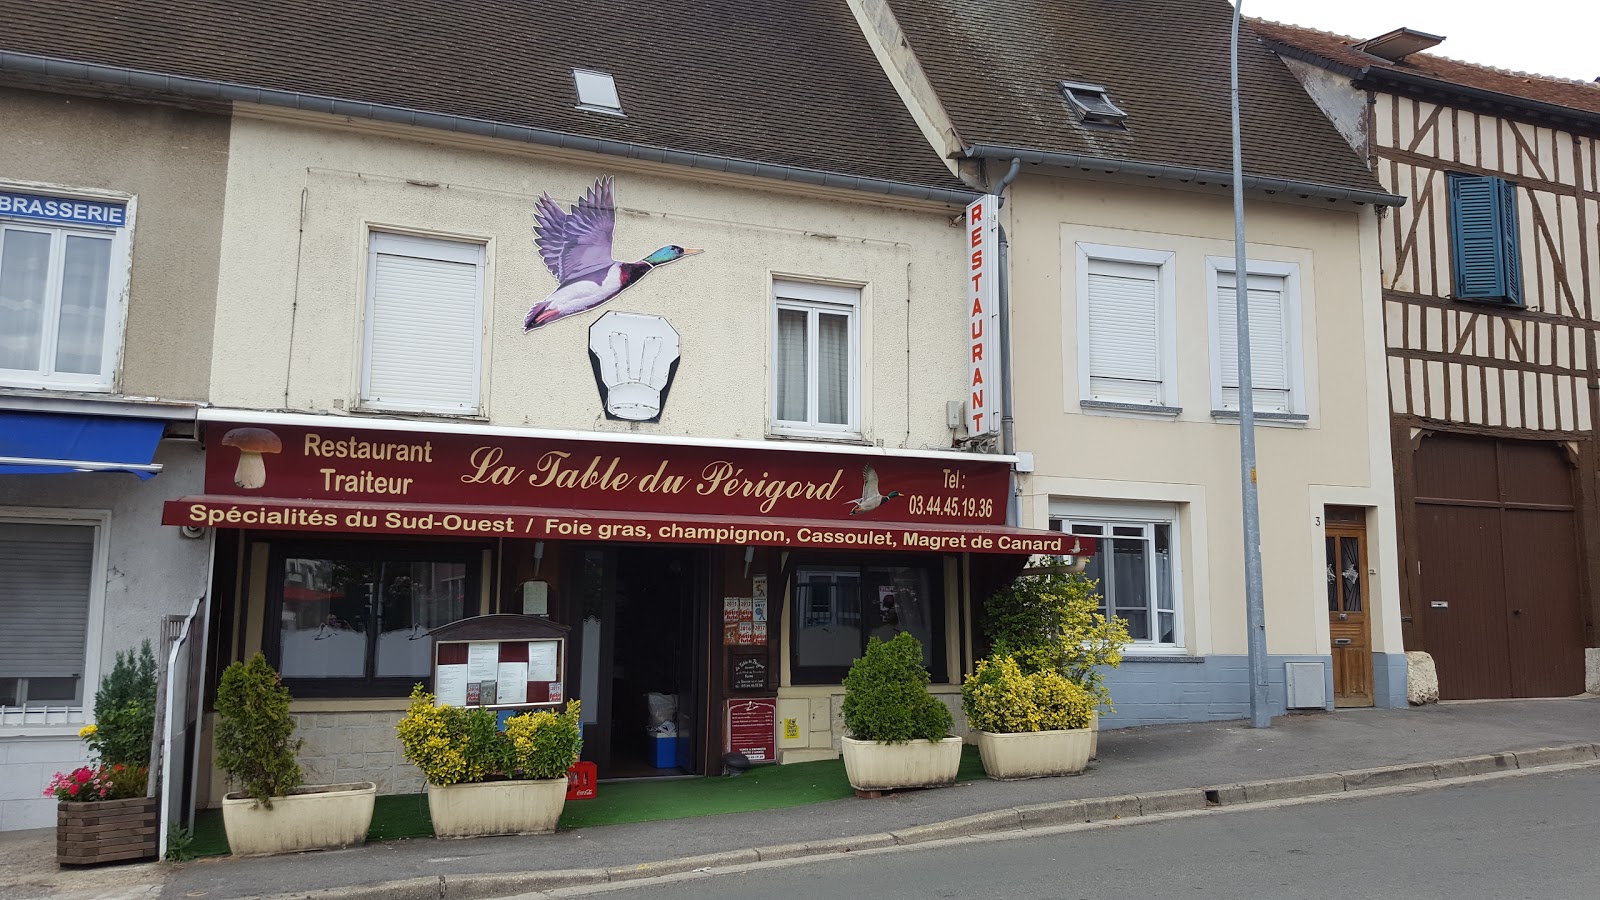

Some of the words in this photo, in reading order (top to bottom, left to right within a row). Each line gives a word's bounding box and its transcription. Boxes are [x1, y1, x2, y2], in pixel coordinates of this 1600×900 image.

[0, 196, 122, 222] BRASSERIE
[971, 203, 983, 433] RESTAURANT
[304, 433, 433, 463] Restaurant
[319, 468, 414, 495] Traiteur
[460, 445, 525, 486] La
[528, 450, 635, 492] Table
[636, 460, 692, 495] du
[695, 460, 845, 514] Périgord
[943, 468, 960, 489] Tel
[909, 494, 993, 518] 03.44.45.19.36
[189, 503, 338, 527] Spécialités
[345, 511, 377, 528] du
[385, 512, 515, 533] Sud-Ouest
[545, 518, 592, 536] Foie
[598, 524, 652, 541] gras,
[658, 523, 791, 546] champignon,
[796, 527, 897, 548] Cassoulet,
[903, 531, 967, 551] Magret
[970, 534, 993, 549] de
[997, 535, 1062, 552] Canard
[1315, 516, 1321, 527] 3
